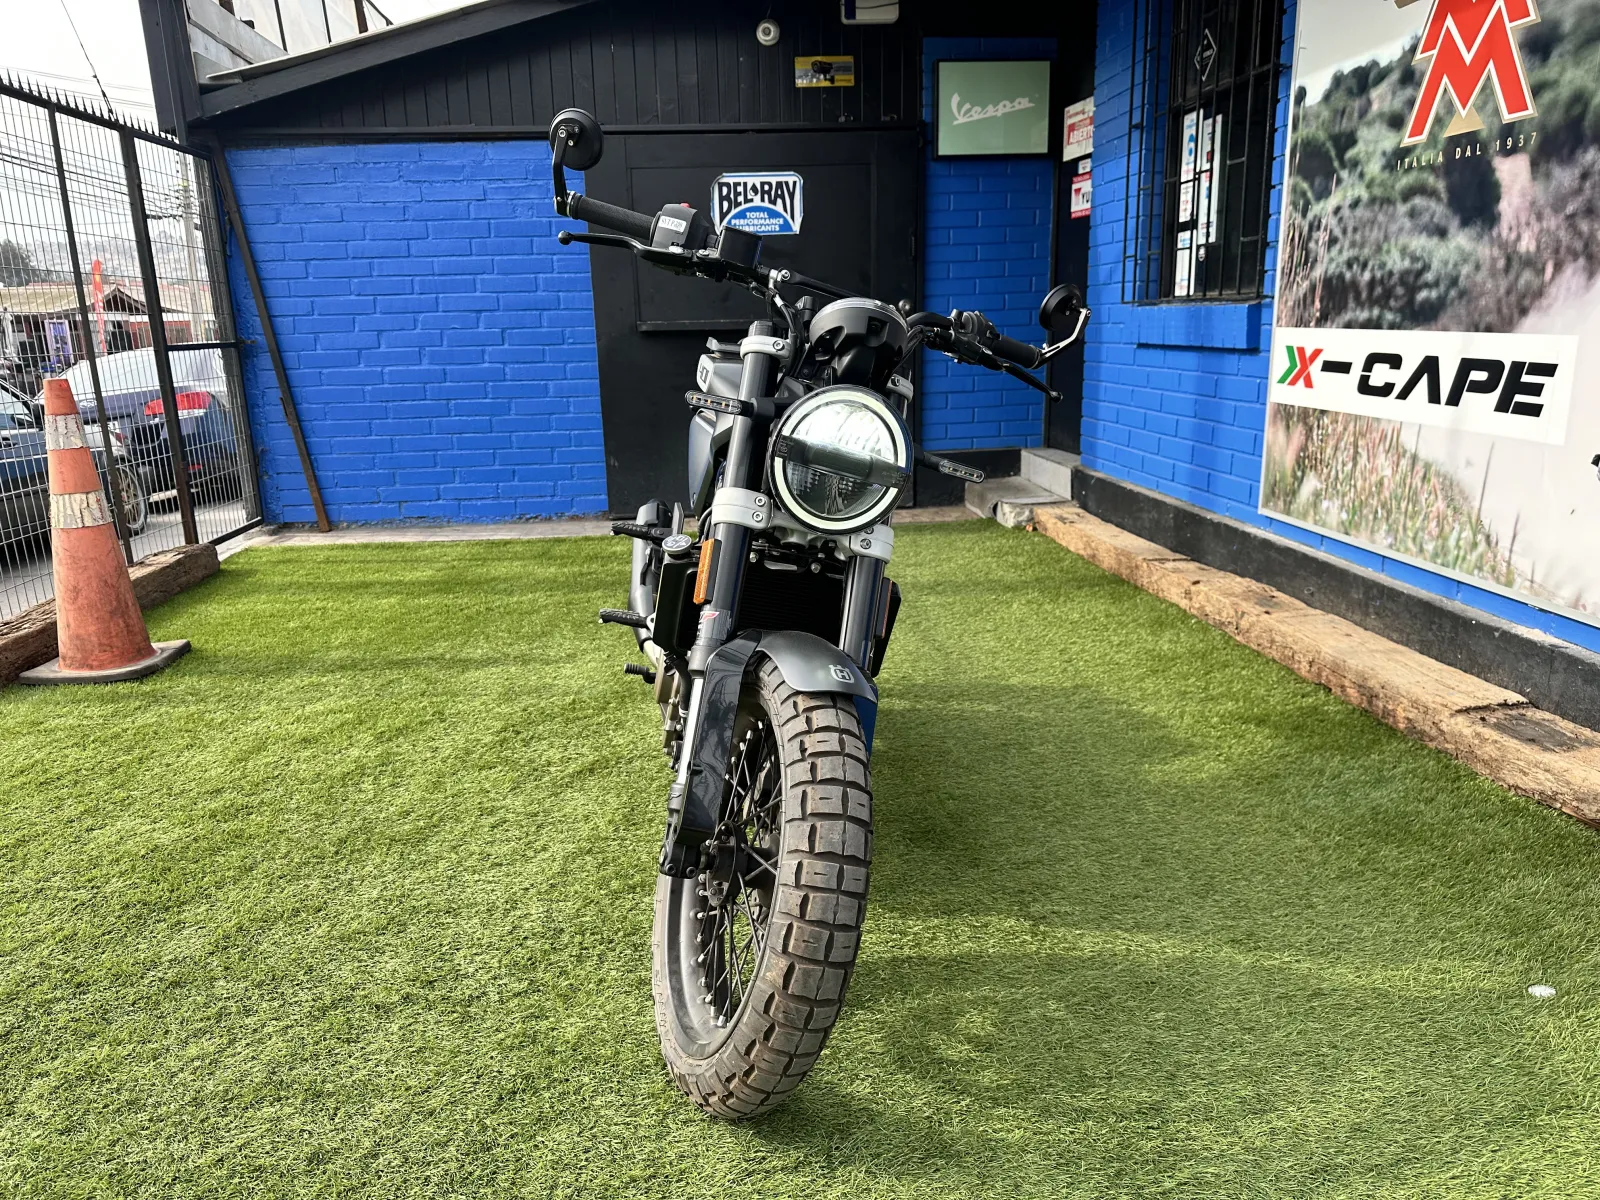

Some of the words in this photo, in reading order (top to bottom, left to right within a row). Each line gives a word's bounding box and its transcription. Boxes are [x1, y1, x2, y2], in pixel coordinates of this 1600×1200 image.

[950, 92, 1036, 126] Vespa
[1396, 151, 1444, 171] ITALIA
[1455, 143, 1481, 160] DAL
[1495, 131, 1538, 152] 1937
[731, 218, 784, 226] PERFORMANCE
[745, 211, 769, 219] TOTAL
[1276, 345, 1559, 418] X-CAPE
